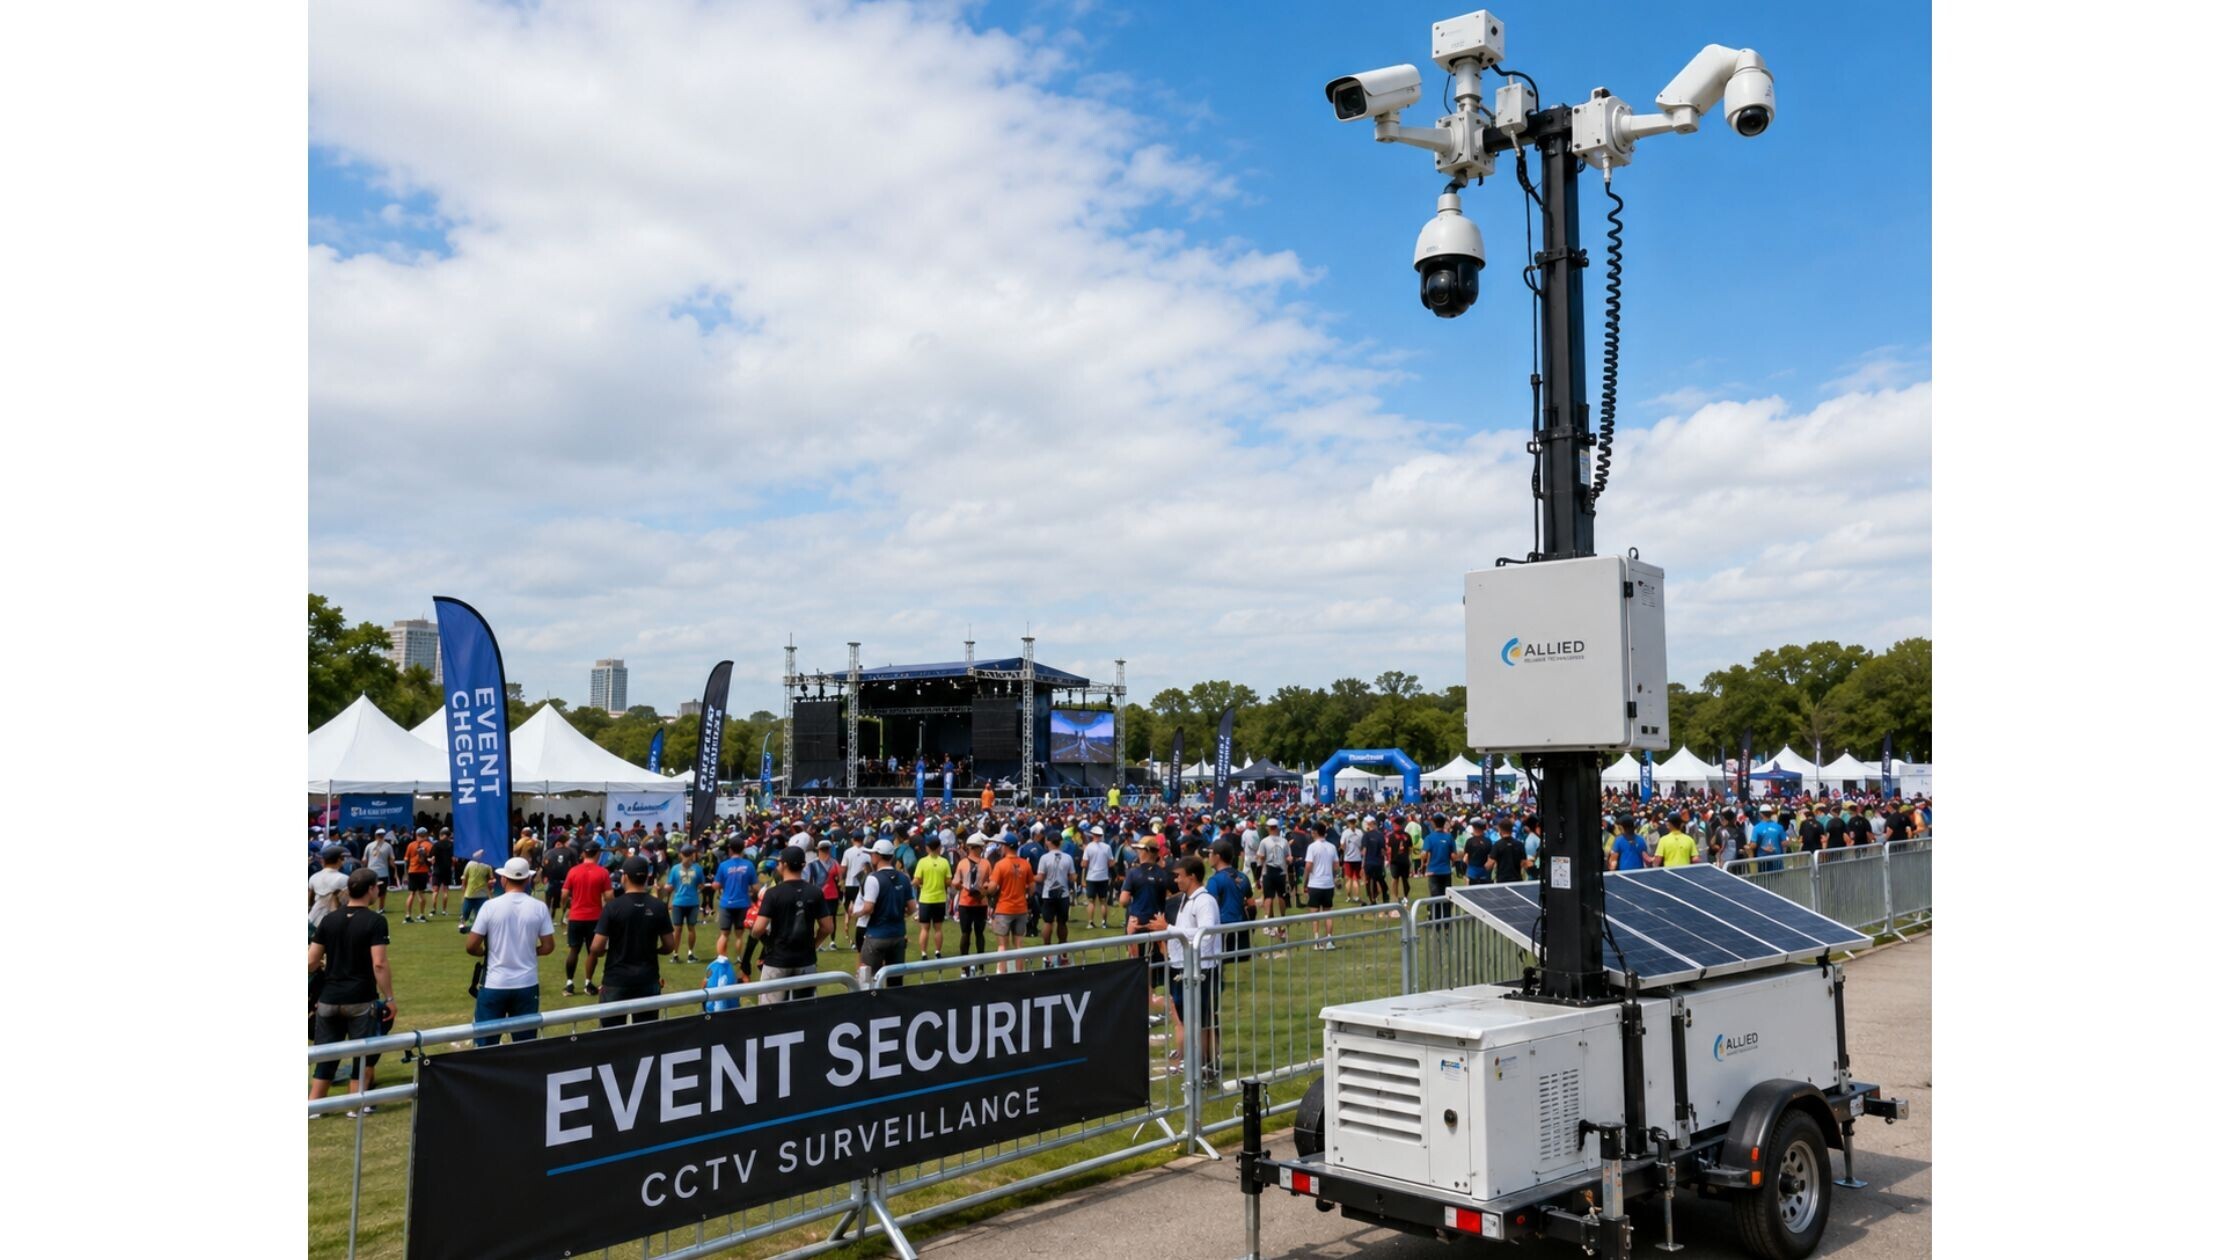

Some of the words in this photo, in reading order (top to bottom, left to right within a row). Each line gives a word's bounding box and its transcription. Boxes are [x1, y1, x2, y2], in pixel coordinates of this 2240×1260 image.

[1524, 640, 1585, 657] ALLIED
[475, 687, 500, 797] EVENT
[546, 1030, 805, 1147] EVENT
[825, 991, 1092, 1088] SECURITY
[641, 1150, 757, 1207] CCTV
[778, 1086, 1040, 1173] SURVEILLANCE
